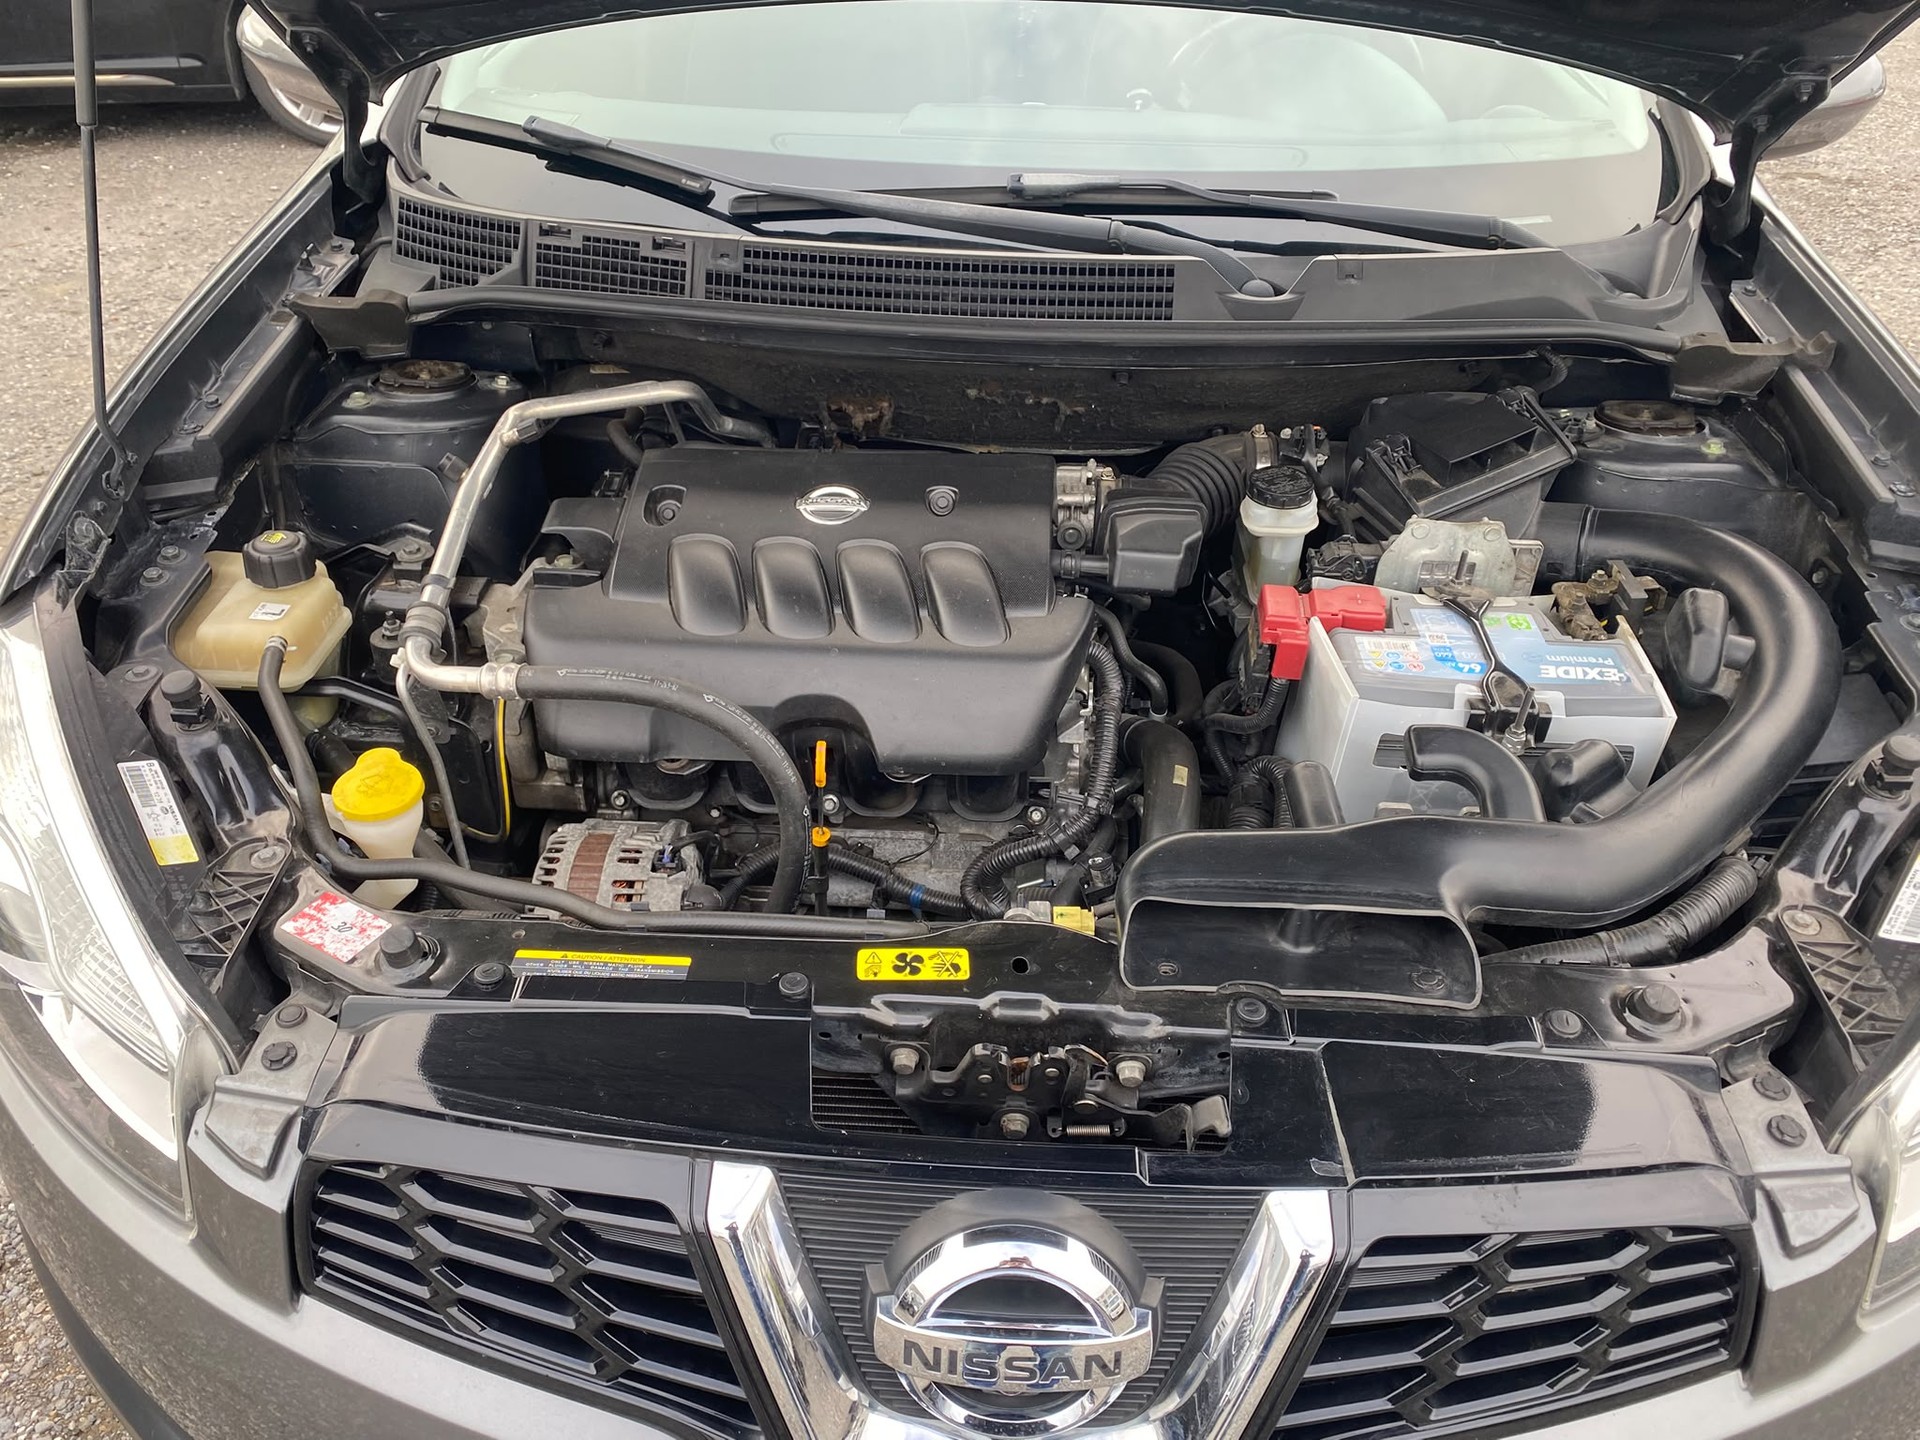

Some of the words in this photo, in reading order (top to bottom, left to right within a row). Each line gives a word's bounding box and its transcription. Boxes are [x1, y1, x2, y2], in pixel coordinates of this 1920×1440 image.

[1546, 654, 1614, 666] Premium
[1539, 664, 1619, 682] EXIDE
[331, 921, 353, 933] 30
[608, 955, 646, 963] ATTENTION
[902, 1339, 1122, 1384] NISSAN
